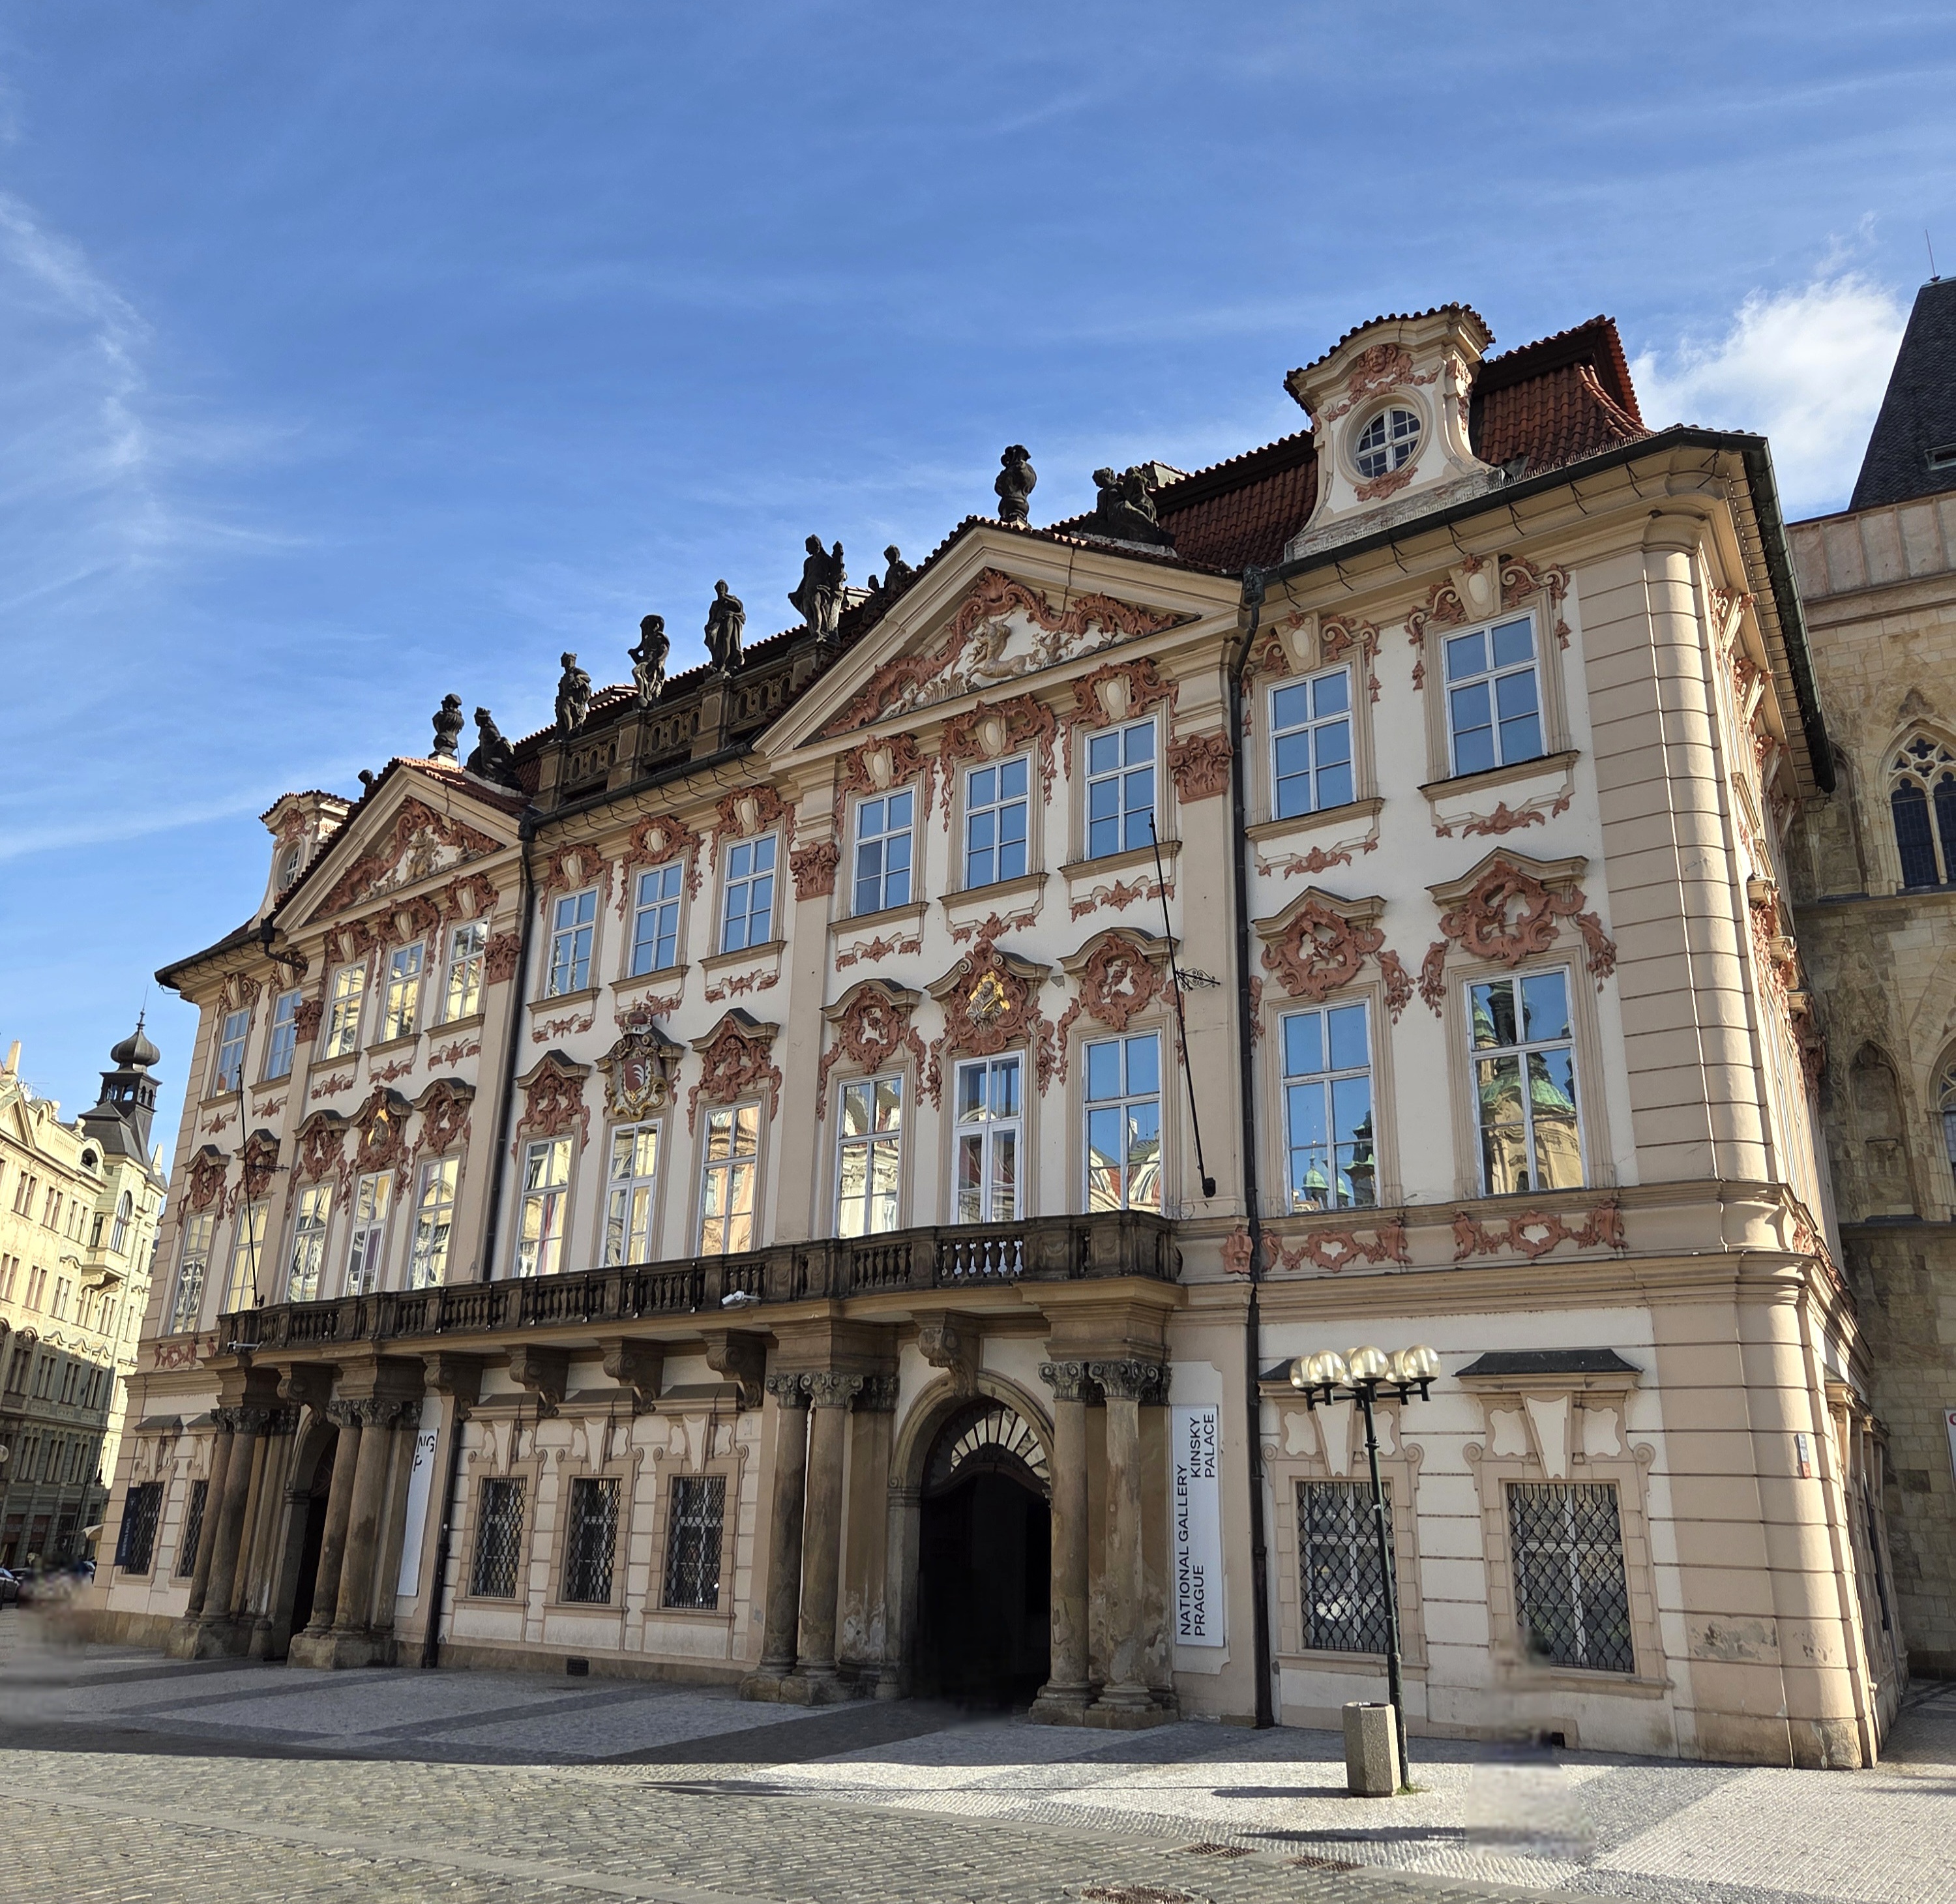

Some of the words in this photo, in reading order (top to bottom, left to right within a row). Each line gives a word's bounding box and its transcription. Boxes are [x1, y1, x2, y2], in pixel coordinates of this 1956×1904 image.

[1190, 1416, 1201, 1478] KINSKY
[1204, 1414, 1215, 1478] PALACE
[1177, 1464, 1189, 1542] GALLERY
[1179, 1545, 1191, 1635] NATIONAL
[1193, 1565, 1206, 1636] PRAGUE
